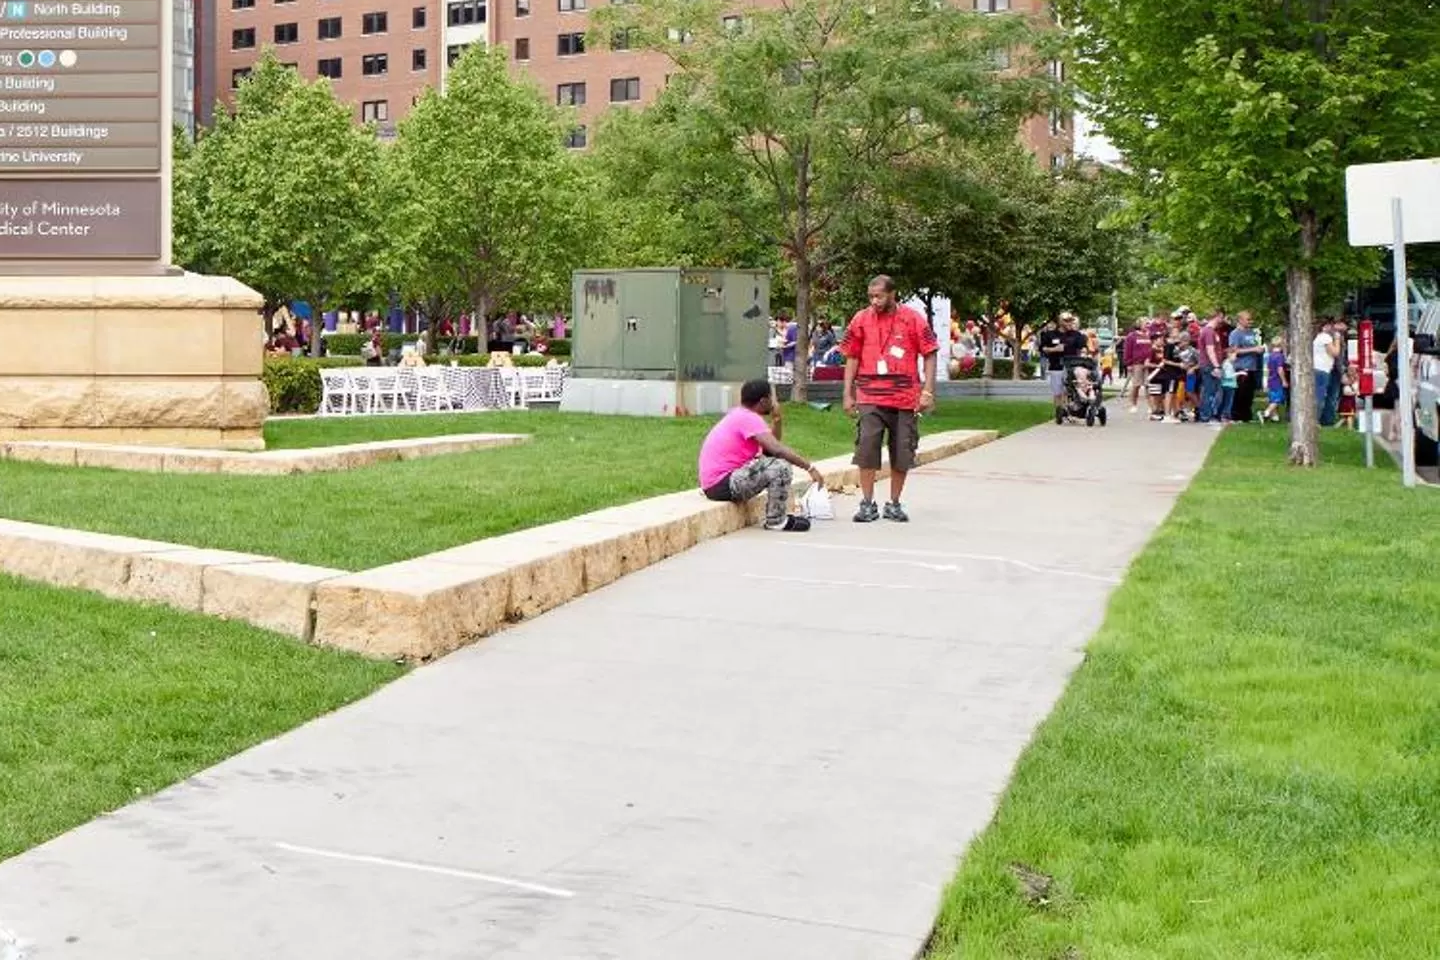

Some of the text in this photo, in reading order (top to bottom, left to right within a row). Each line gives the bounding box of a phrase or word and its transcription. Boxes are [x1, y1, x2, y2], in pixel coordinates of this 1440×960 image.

[34, 4, 68, 15] North
[71, 3, 121, 17] Building
[0, 27, 75, 39] Professional
[78, 27, 128, 40] Building
[5, 76, 55, 91] Building
[51, 125, 109, 139] Buildings
[23, 150, 84, 164] University
[22, 200, 39, 216] of
[41, 201, 121, 216] Minnesota
[37, 222, 92, 236] Center
